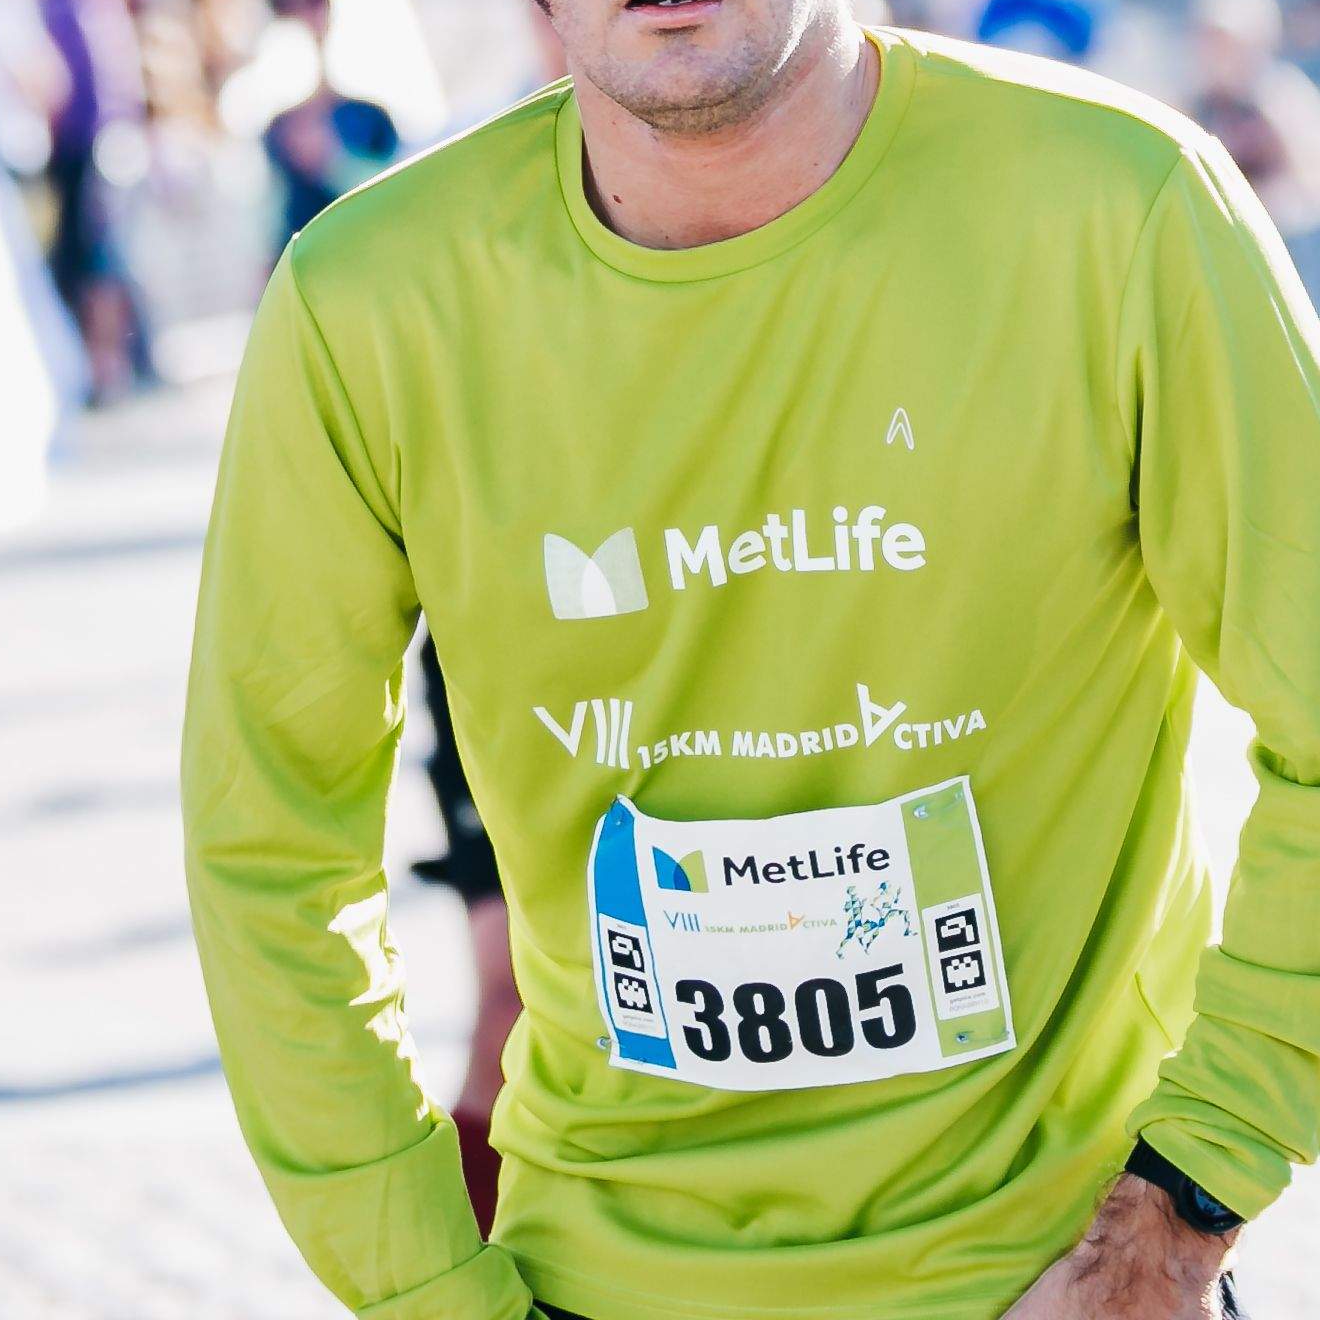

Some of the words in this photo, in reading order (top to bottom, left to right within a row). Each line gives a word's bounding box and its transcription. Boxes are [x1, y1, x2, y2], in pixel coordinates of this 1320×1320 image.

[664, 505, 926, 591] MetLife
[532, 698, 633, 770] VIII
[636, 730, 722, 770] 15KM
[731, 723, 860, 759] MADRID
[723, 843, 890, 886] MetLife
[663, 910, 701, 933] VIII
[675, 963, 918, 1064] 3805
